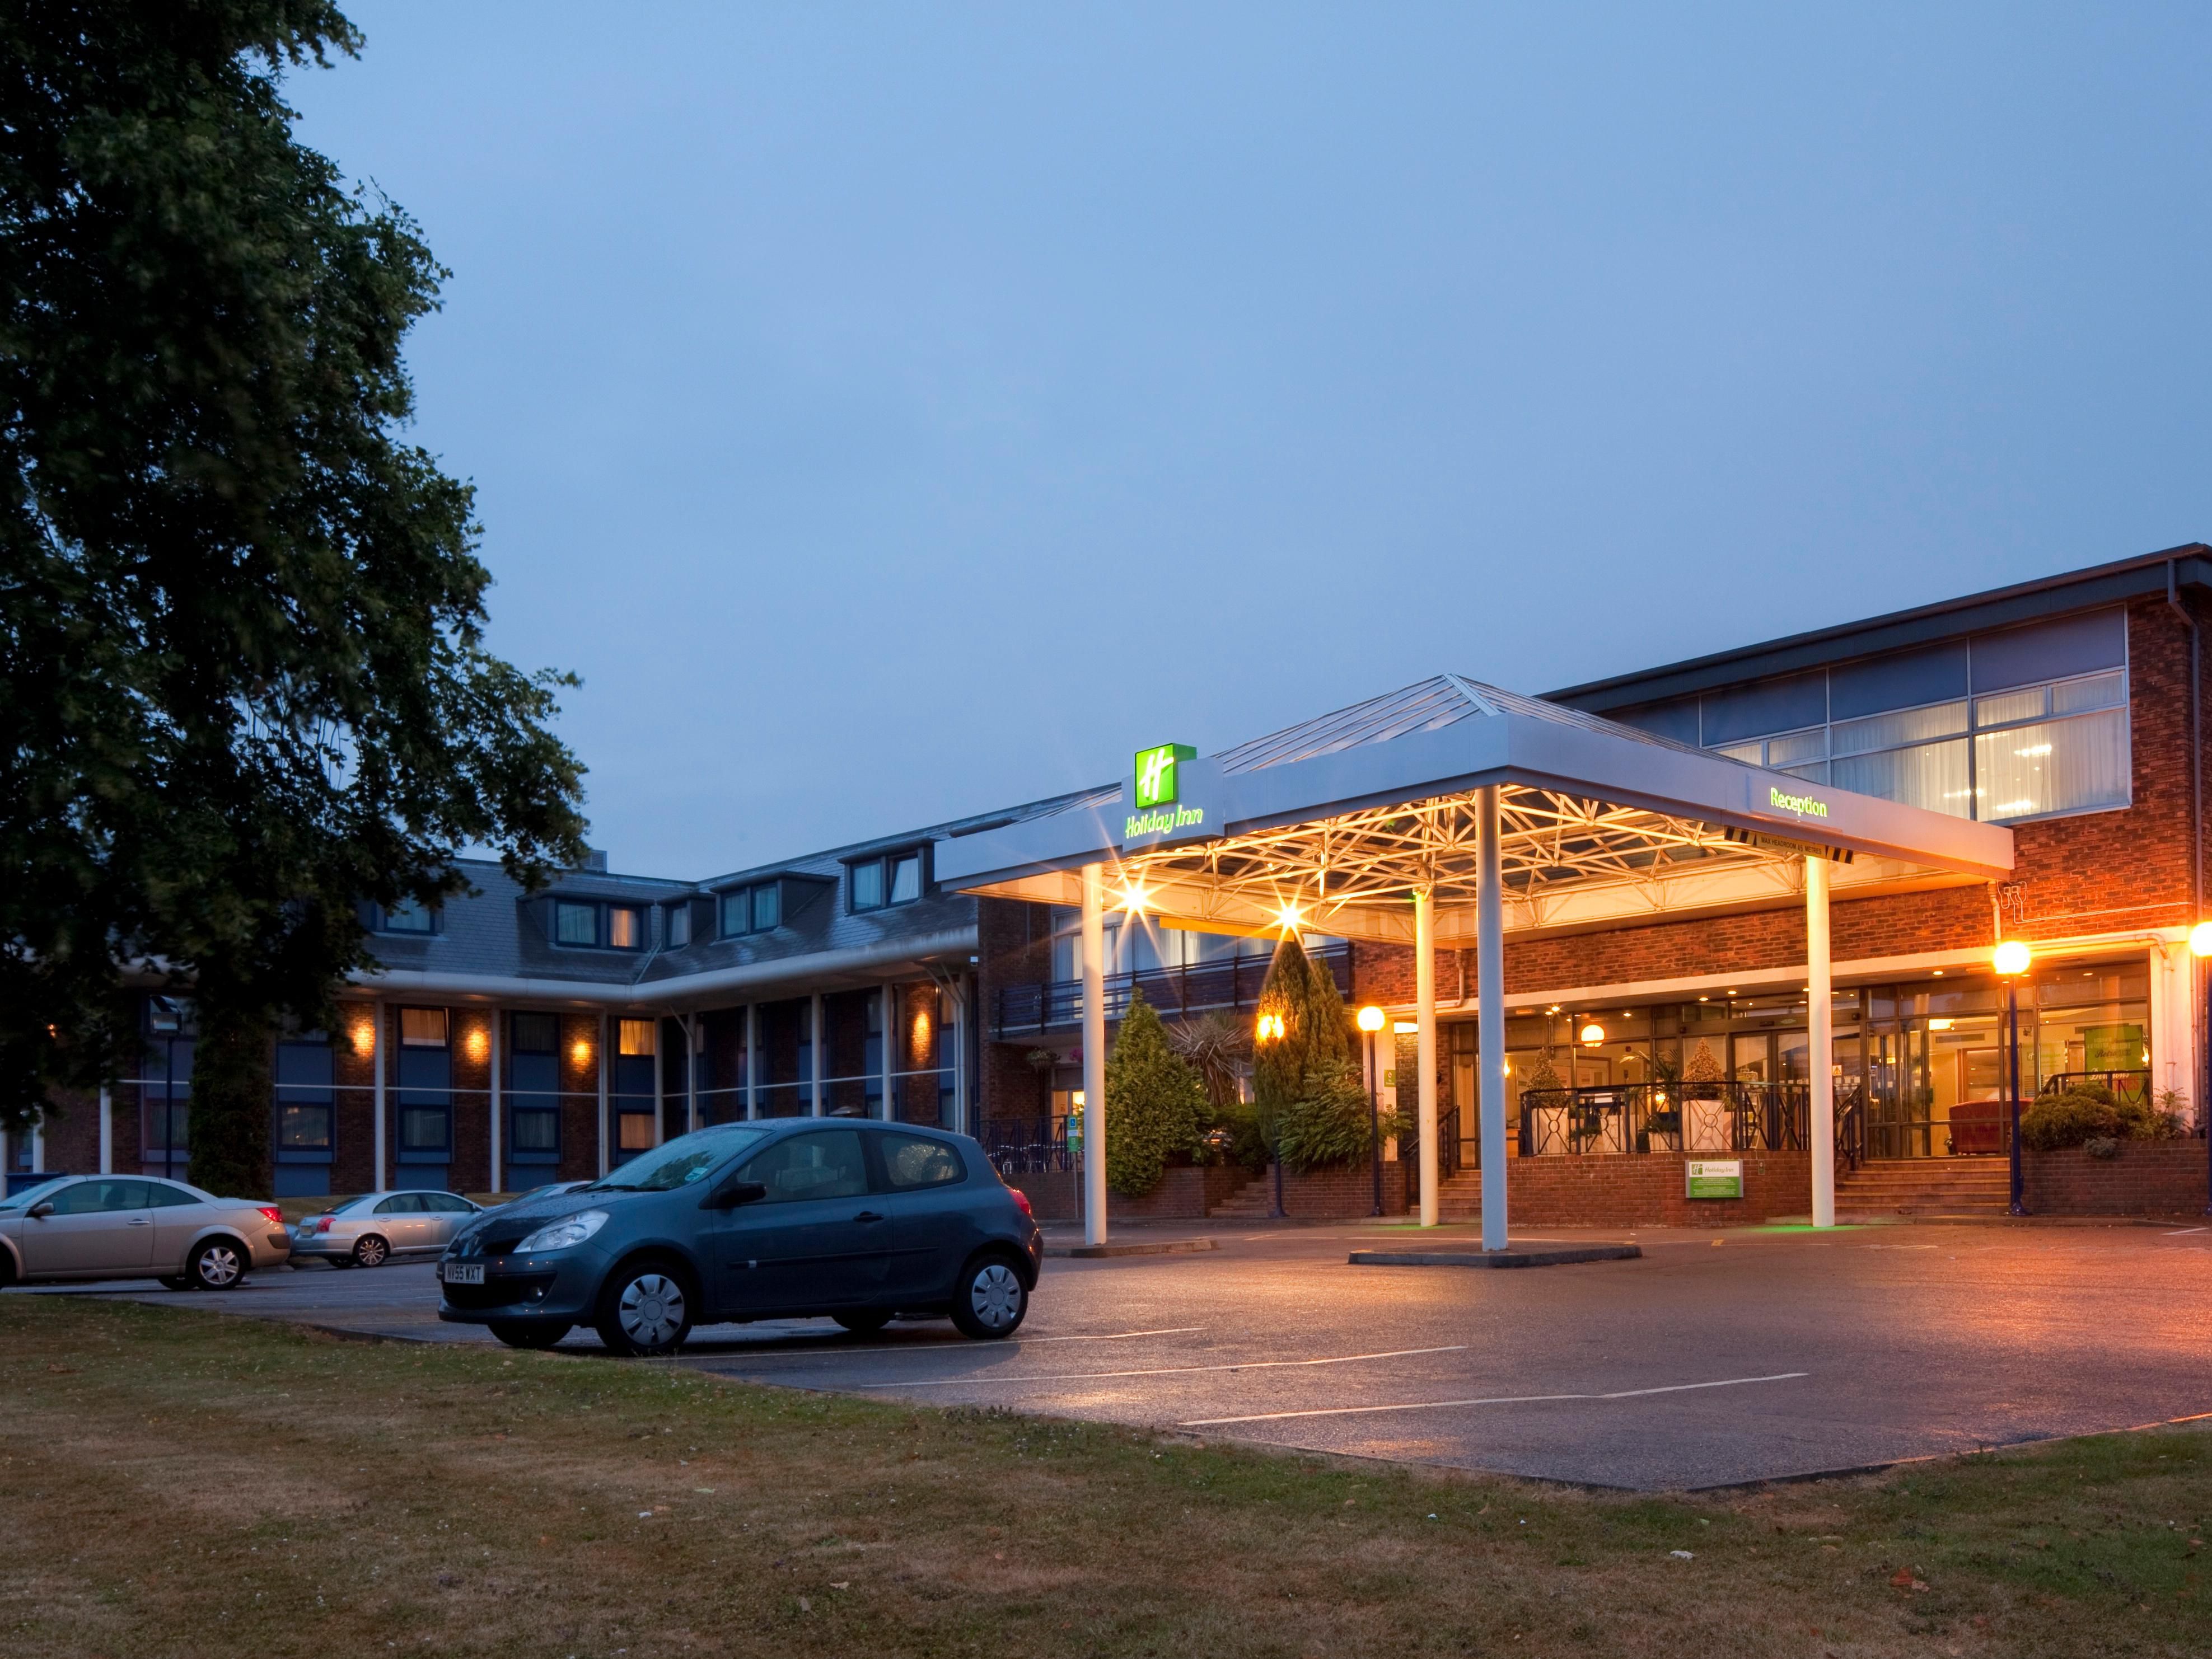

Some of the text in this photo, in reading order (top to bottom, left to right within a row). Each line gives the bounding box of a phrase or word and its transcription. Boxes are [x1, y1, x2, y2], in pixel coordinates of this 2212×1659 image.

[1770, 788, 1828, 817] Reception
[1125, 804, 1203, 839] Holiday Inn
[1771, 838, 1797, 850] HEADROOM
[1804, 846, 1822, 855] METRES
[447, 1265, 481, 1281] NV55 WXT
